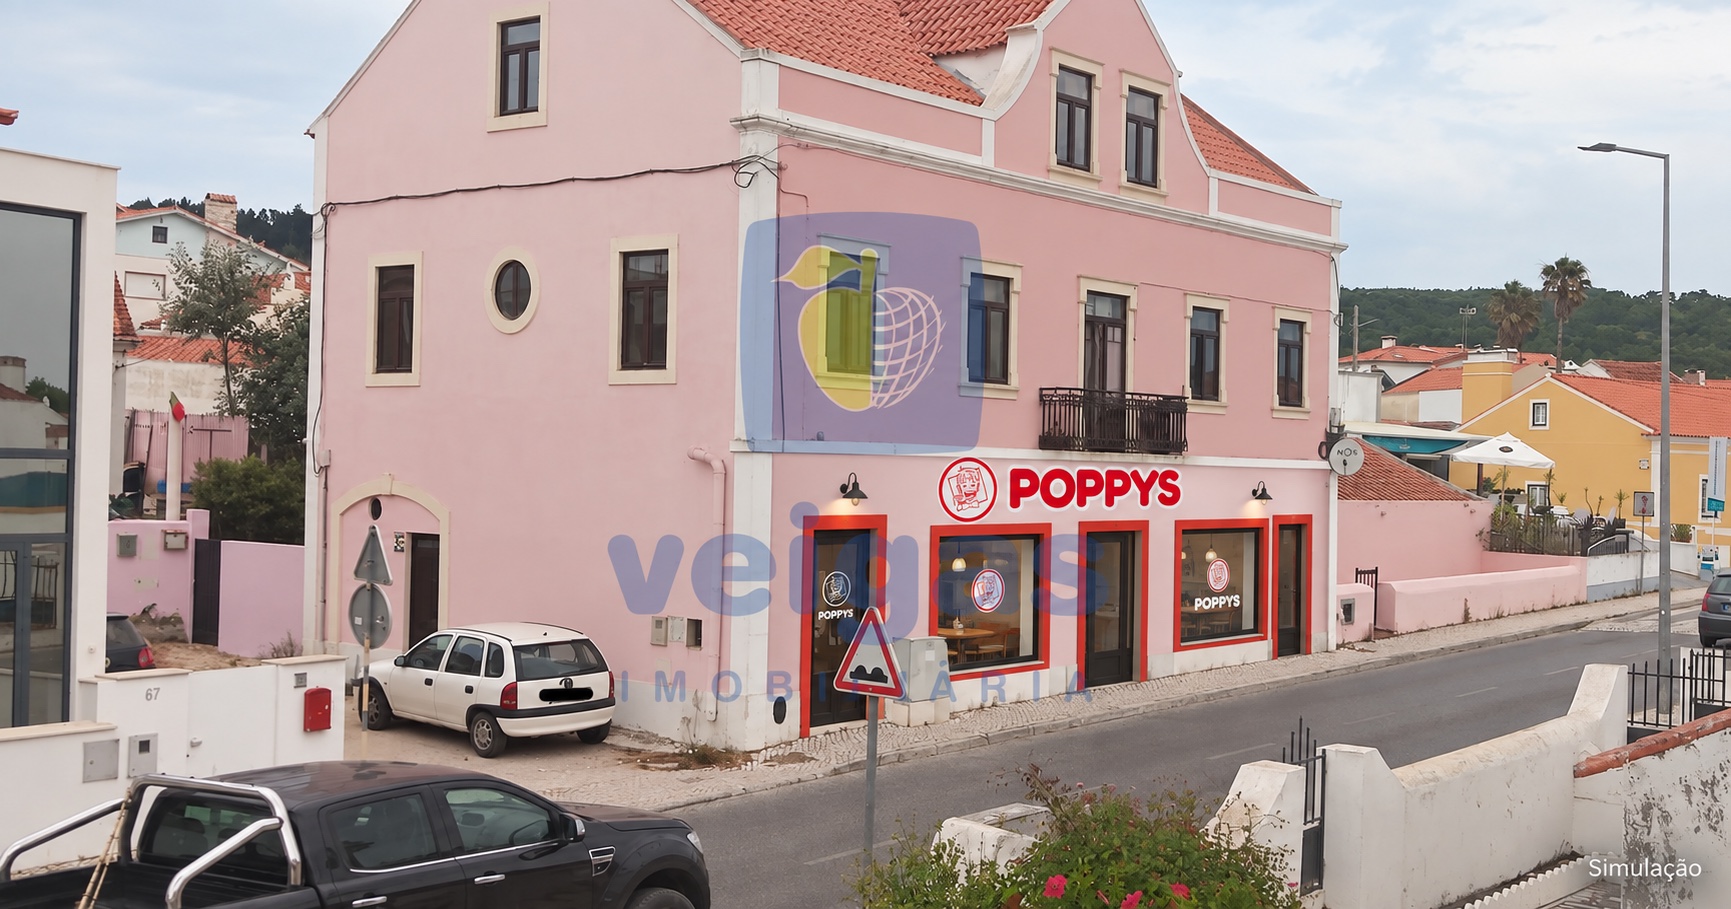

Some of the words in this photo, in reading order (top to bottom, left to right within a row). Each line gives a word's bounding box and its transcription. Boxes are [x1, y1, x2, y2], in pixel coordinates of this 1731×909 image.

[1337, 448, 1358, 457] NOS
[1009, 468, 1182, 509] POPPYS
[1194, 594, 1241, 611] POPPYS
[817, 608, 854, 621] POPPYS
[145, 687, 161, 701] 67
